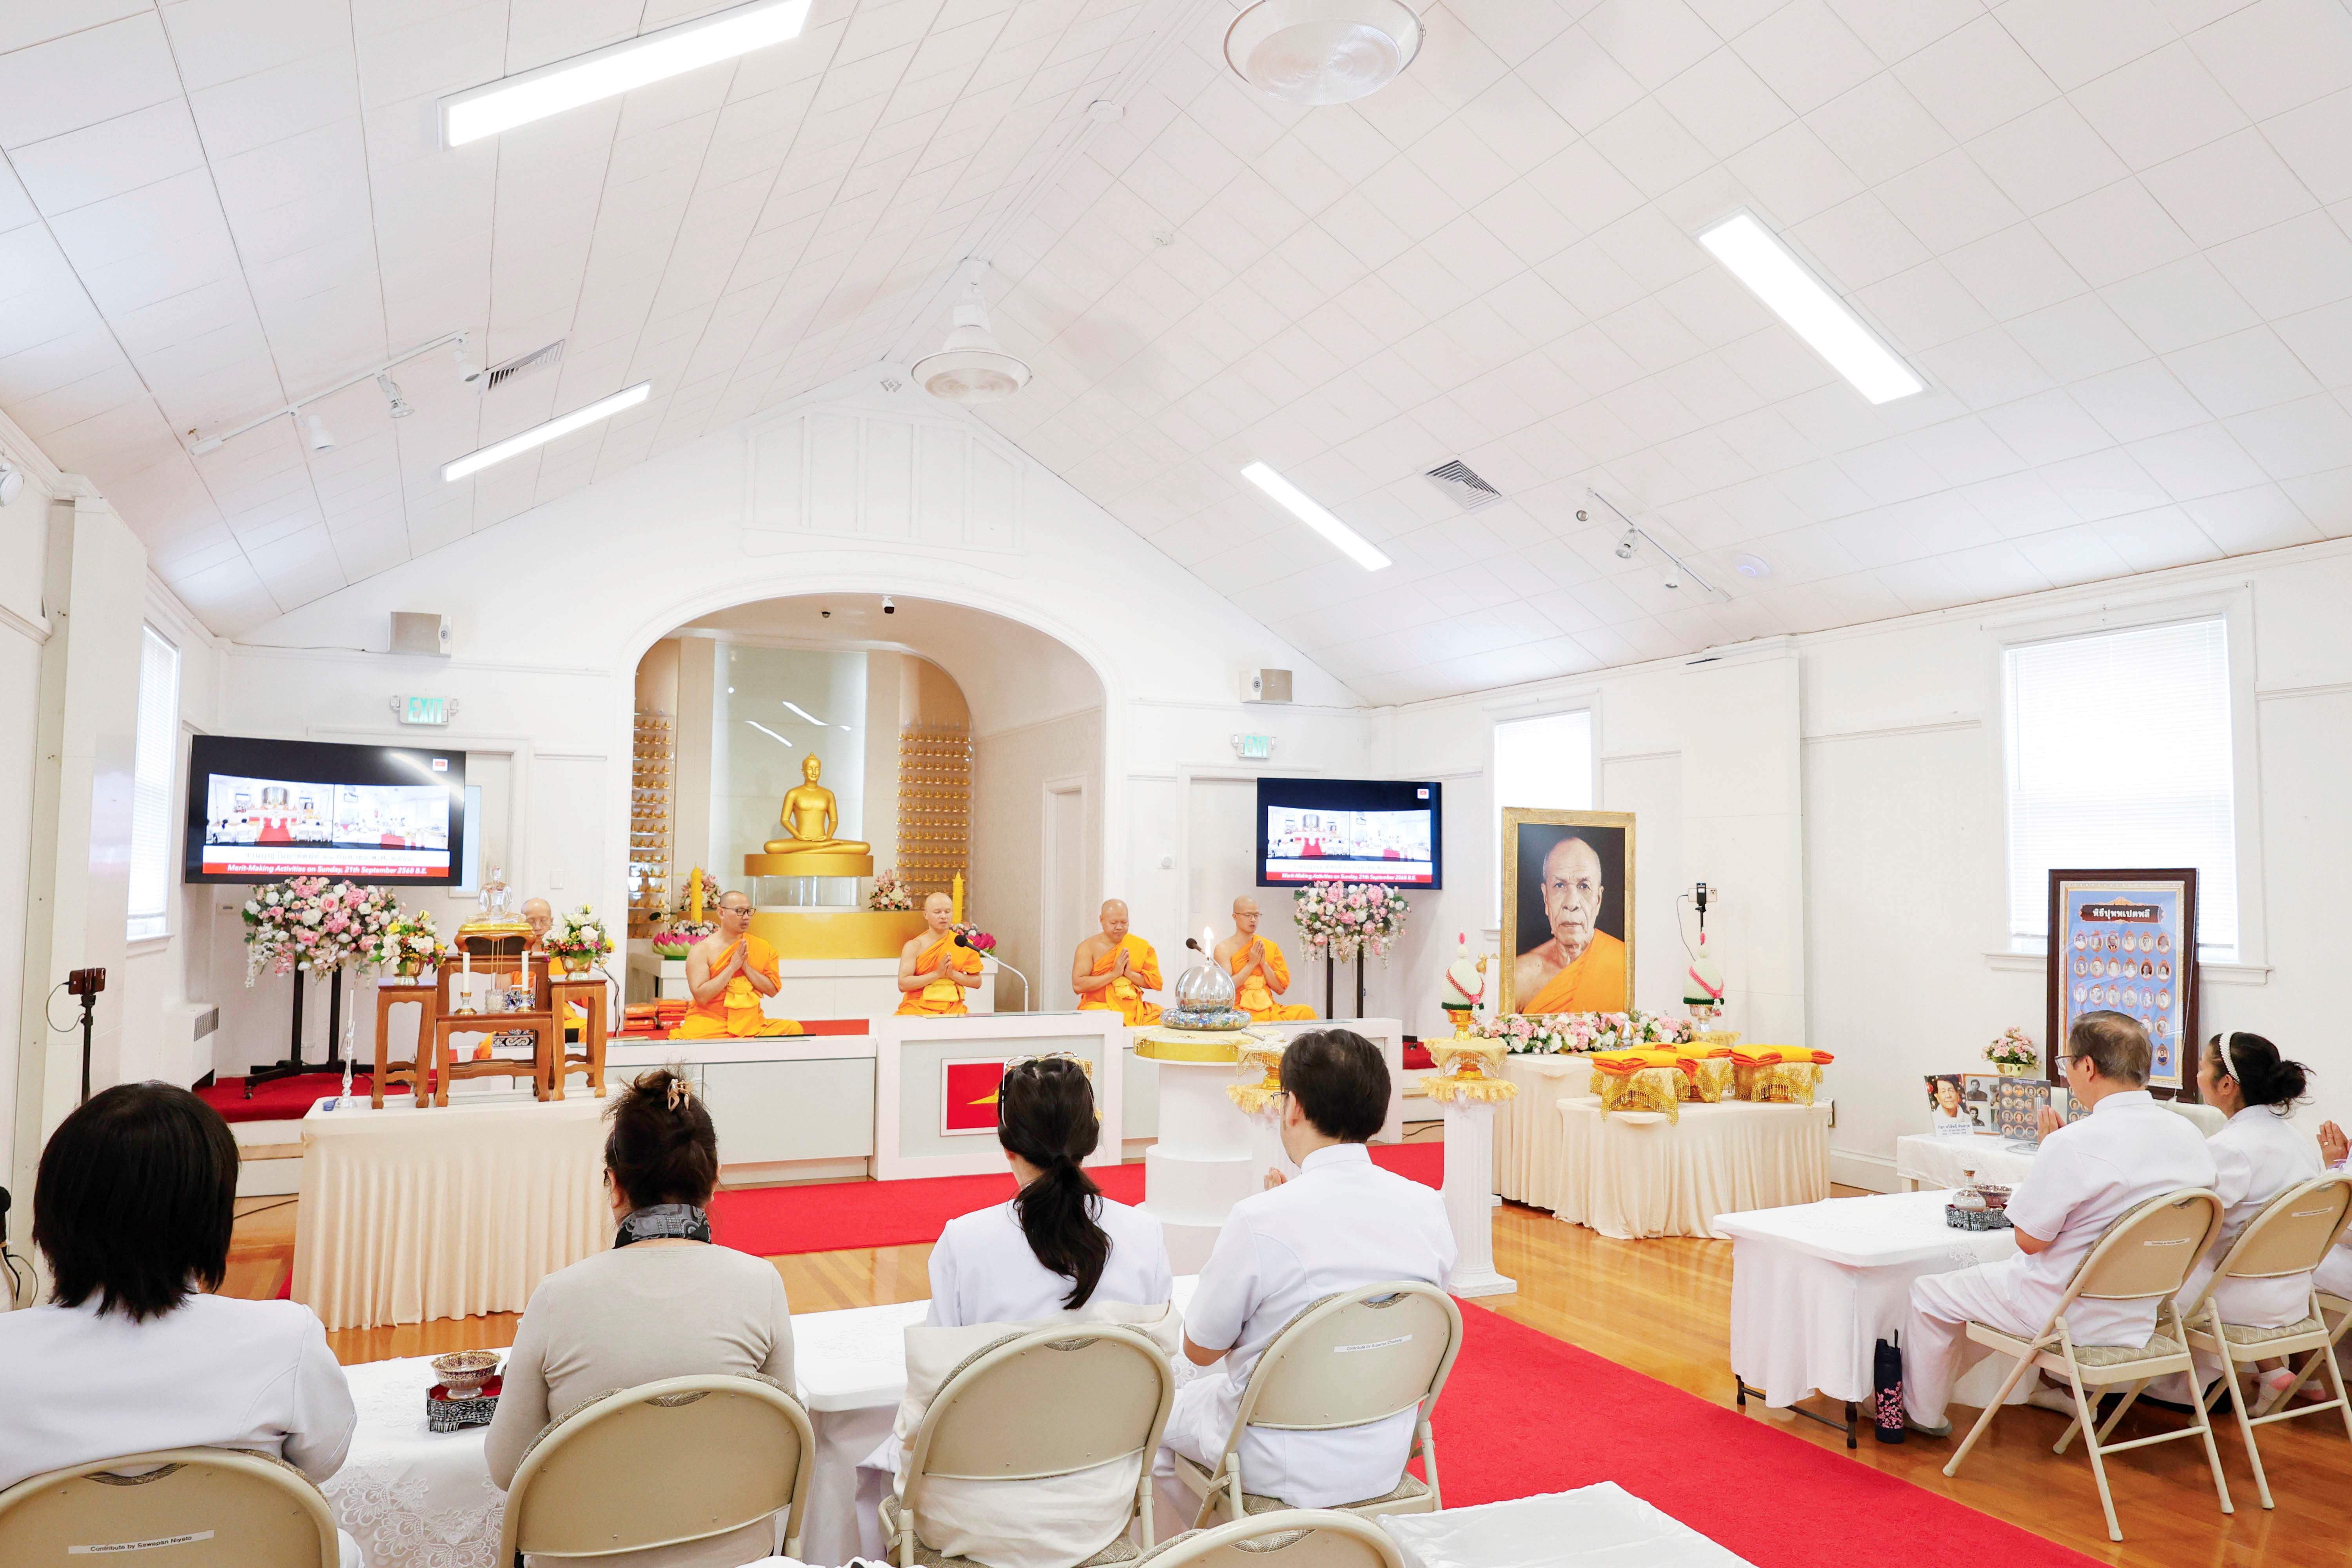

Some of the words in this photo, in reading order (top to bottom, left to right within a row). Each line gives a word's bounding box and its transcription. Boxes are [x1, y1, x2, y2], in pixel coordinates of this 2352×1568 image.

[408, 696, 446, 723] EXIT
[1244, 735, 1268, 757] EXIT
[227, 864, 274, 873] Merit-Making
[318, 866, 343, 874] Sunday,
[361, 866, 397, 875] September
[2092, 908, 2151, 920] พิธีปุพพเปตพลี
